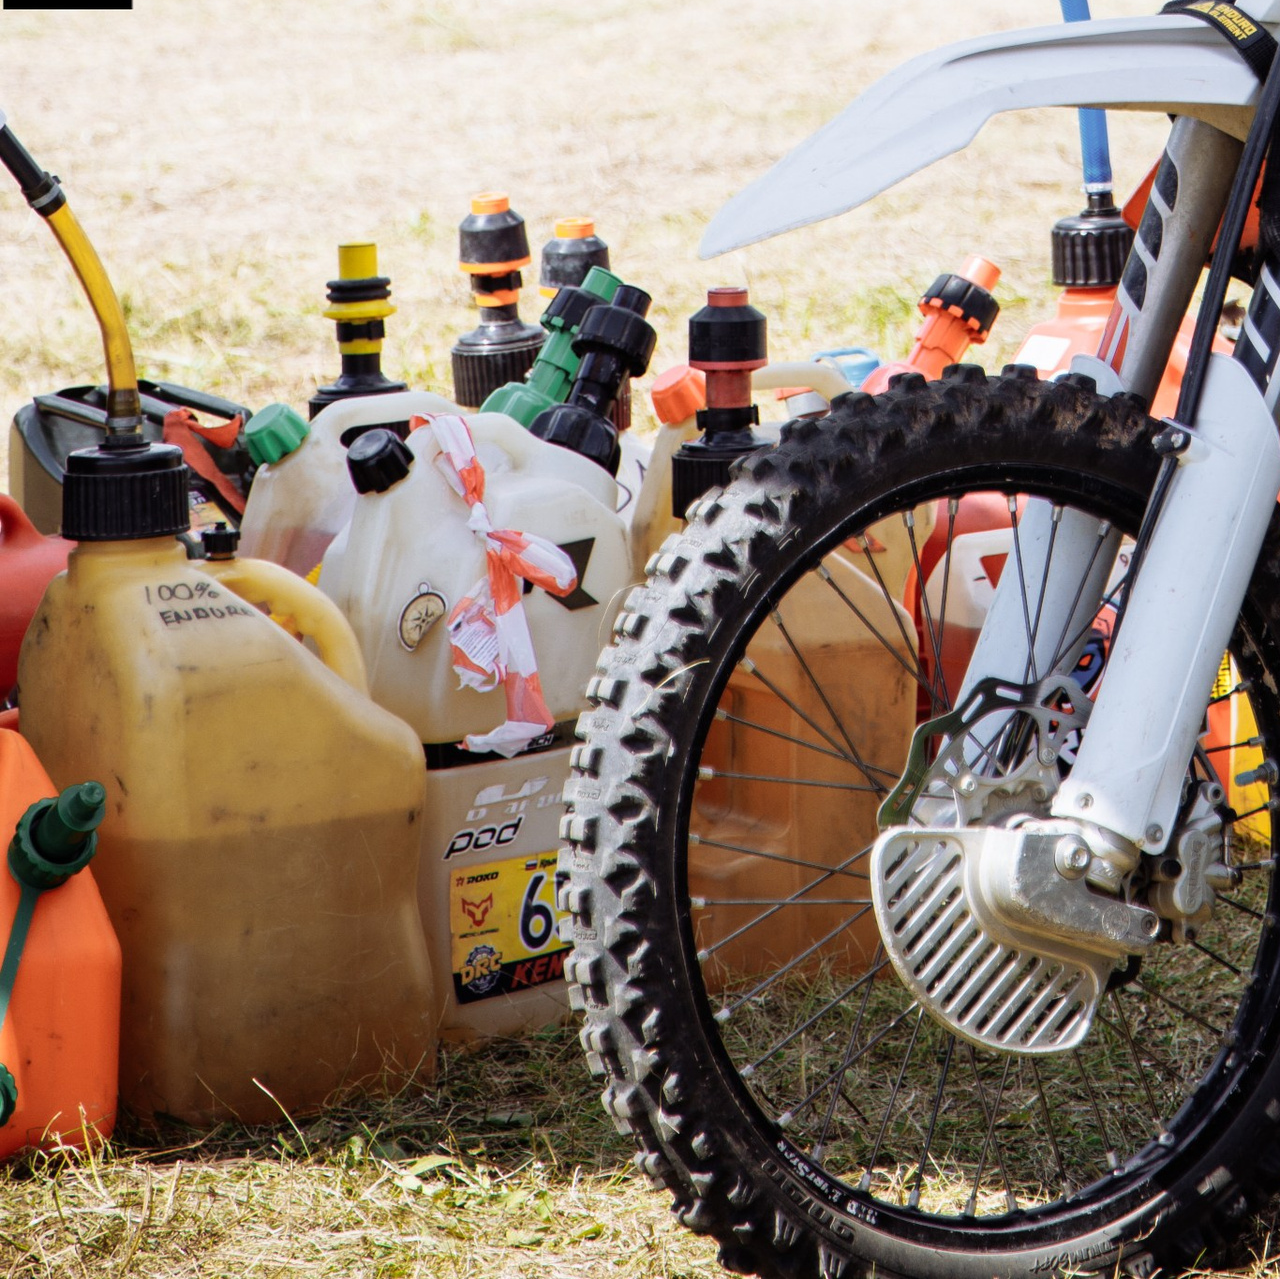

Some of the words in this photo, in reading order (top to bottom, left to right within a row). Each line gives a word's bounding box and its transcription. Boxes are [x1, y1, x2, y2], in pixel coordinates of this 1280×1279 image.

[1208, 9, 1248, 41] ELEMENT
[1214, 3, 1259, 37] ENDURO
[144, 581, 220, 605] 100%
[443, 815, 525, 861] pod
[461, 952, 503, 986] DRC
